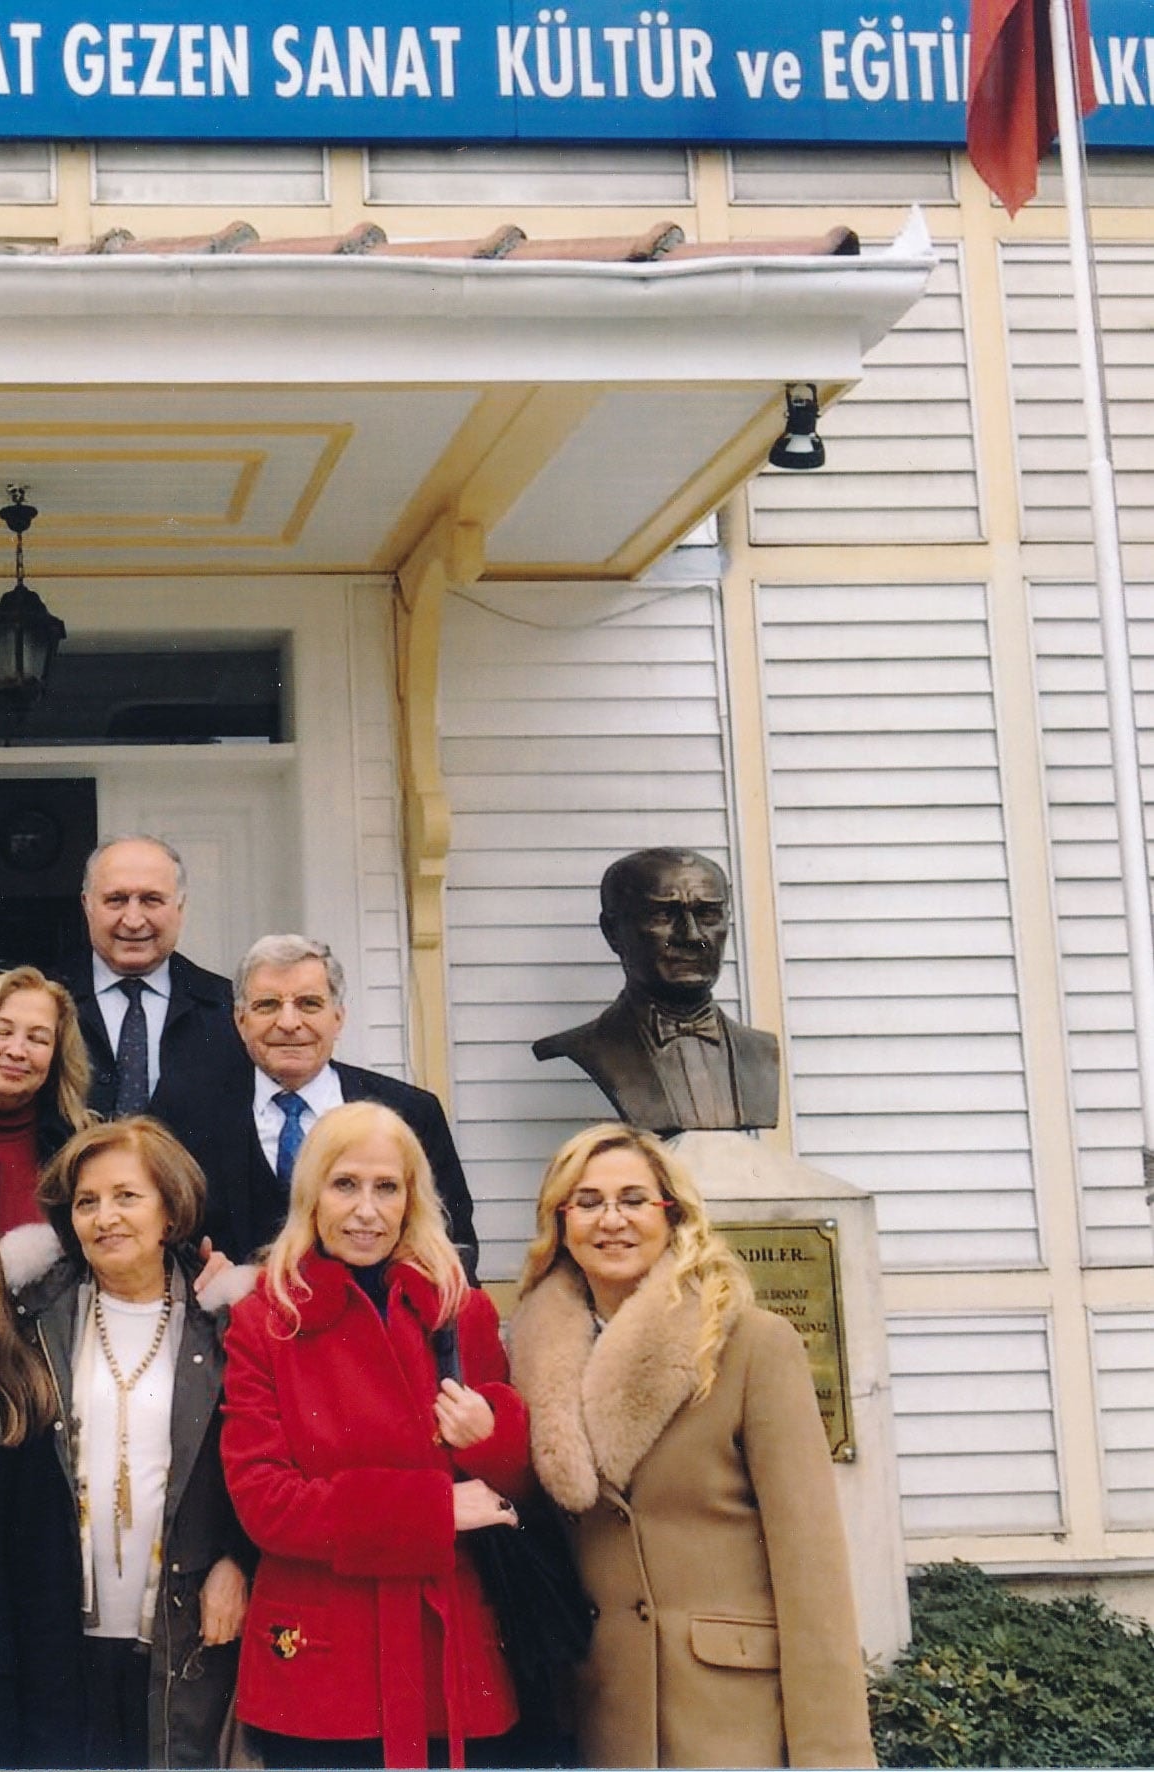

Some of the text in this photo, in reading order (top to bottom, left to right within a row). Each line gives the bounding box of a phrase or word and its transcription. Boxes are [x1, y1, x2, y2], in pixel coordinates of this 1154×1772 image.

[63, 22, 250, 98] GEZEN
[273, 24, 461, 98] SANAT
[496, 8, 717, 99] KÜLTÜR
[736, 51, 802, 100] ve
[822, 15, 971, 103] EĞİTİ
